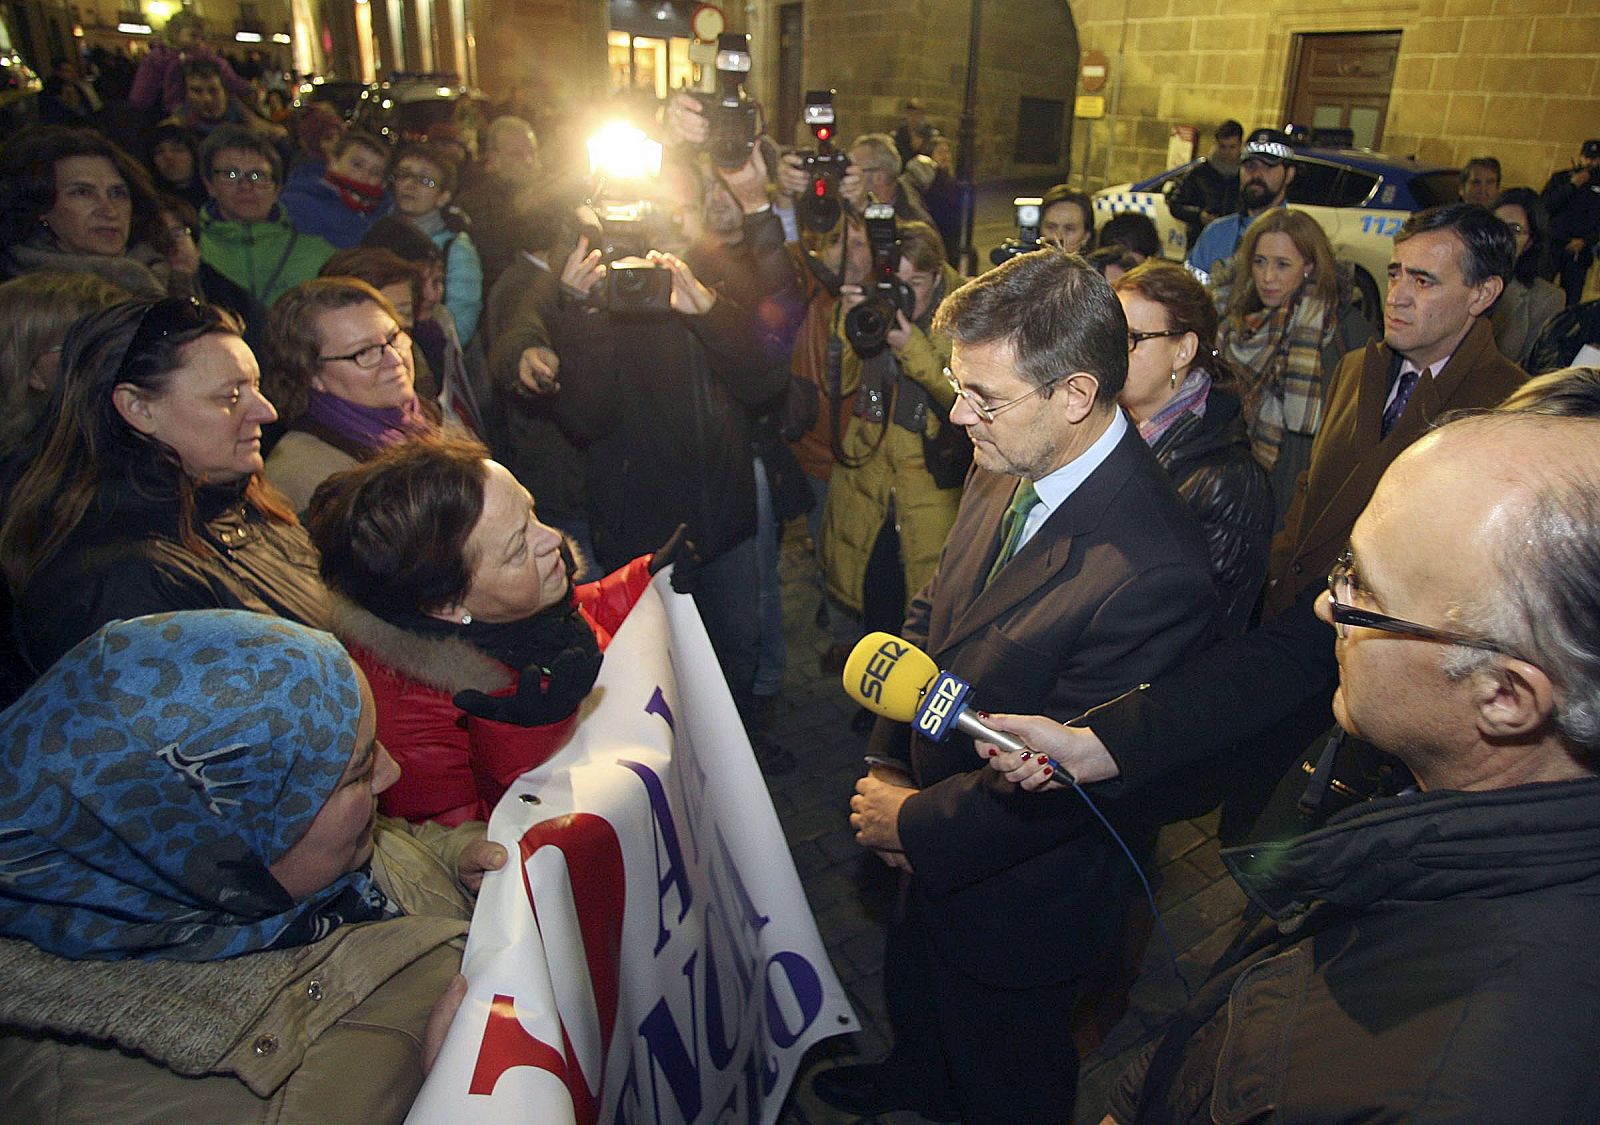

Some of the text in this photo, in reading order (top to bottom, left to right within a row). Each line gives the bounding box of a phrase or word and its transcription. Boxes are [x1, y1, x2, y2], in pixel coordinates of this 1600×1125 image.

[1361, 216, 1404, 237] 112
[860, 640, 909, 705] SER
[919, 677, 964, 735] SER
